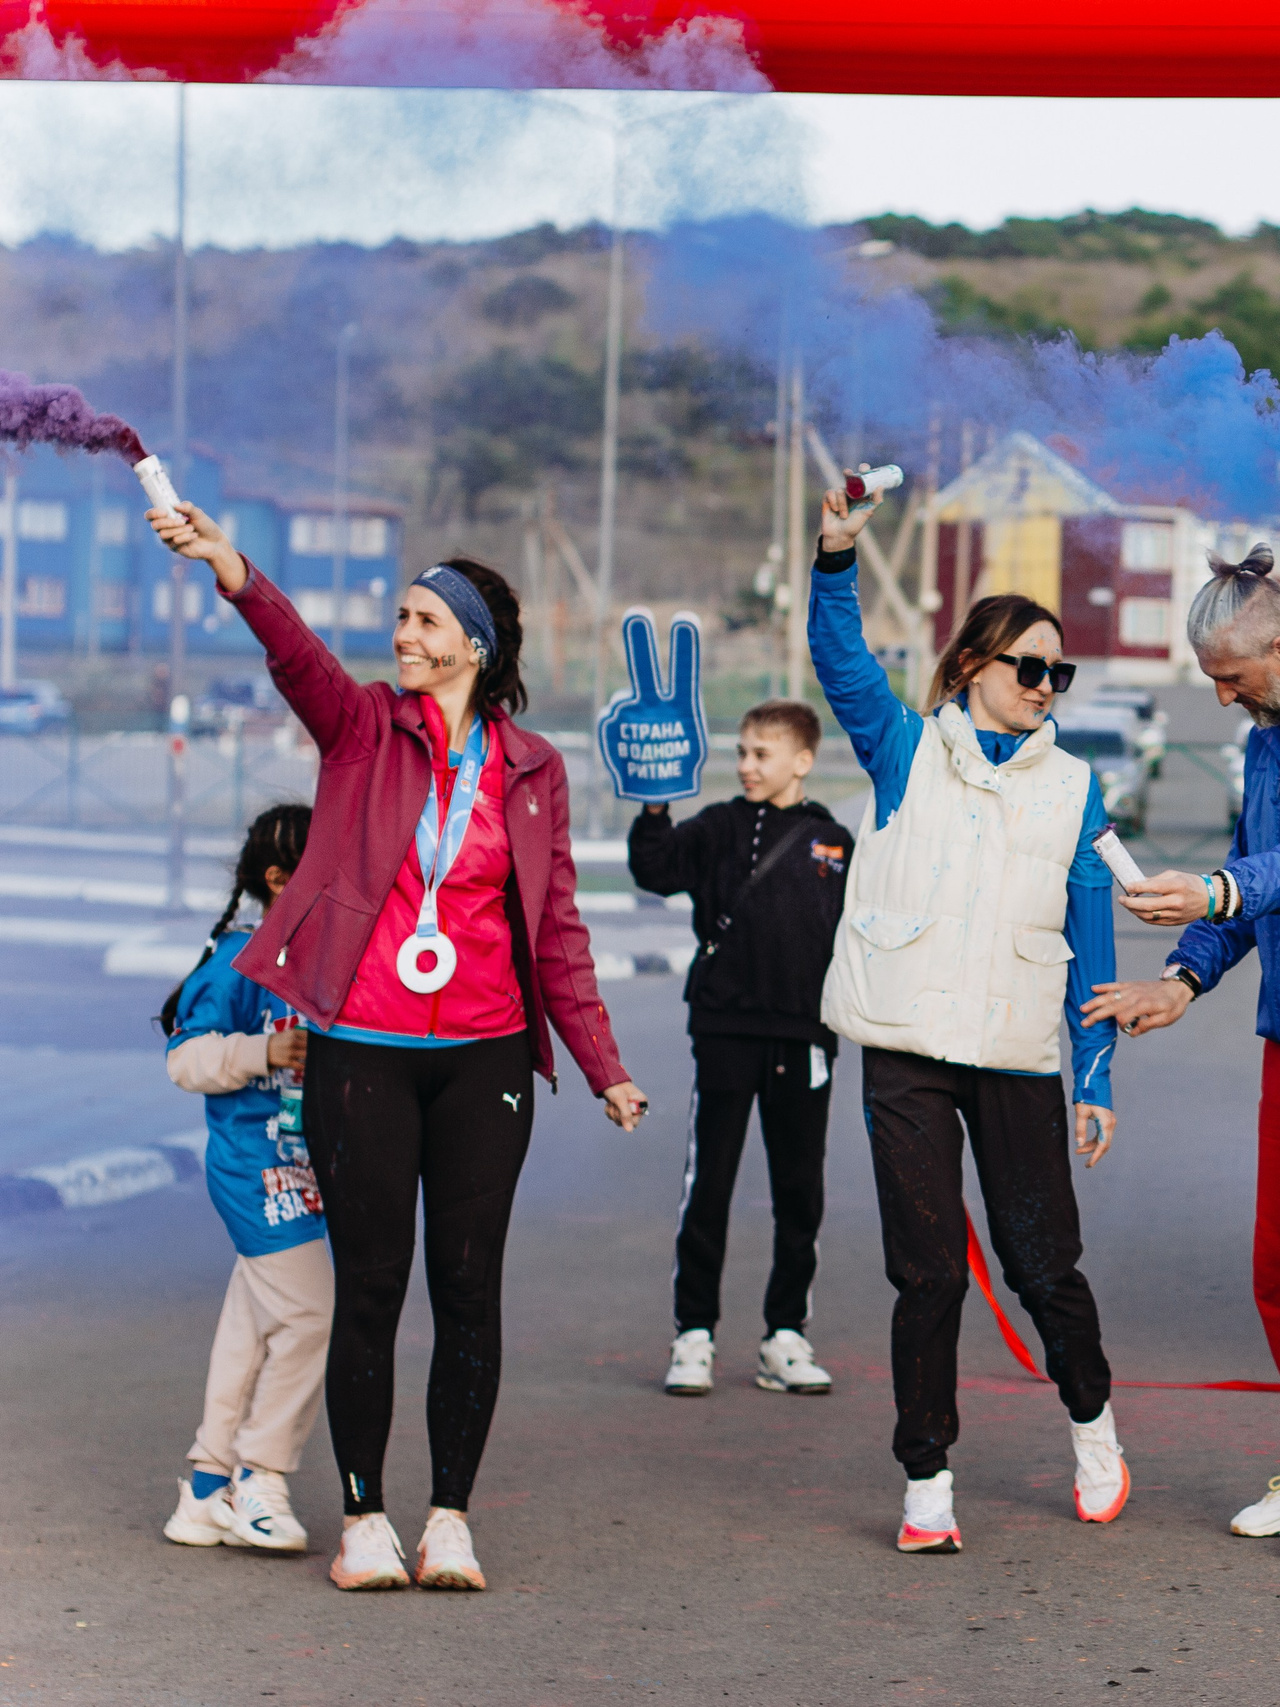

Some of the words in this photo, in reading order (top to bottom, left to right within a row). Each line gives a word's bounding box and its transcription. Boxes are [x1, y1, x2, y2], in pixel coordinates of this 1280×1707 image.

[620, 721, 685, 740] СТРАНА
[617, 742, 628, 758] В
[629, 740, 690, 761] ОДНОМ
[627, 760, 682, 779] РИТМЕ
